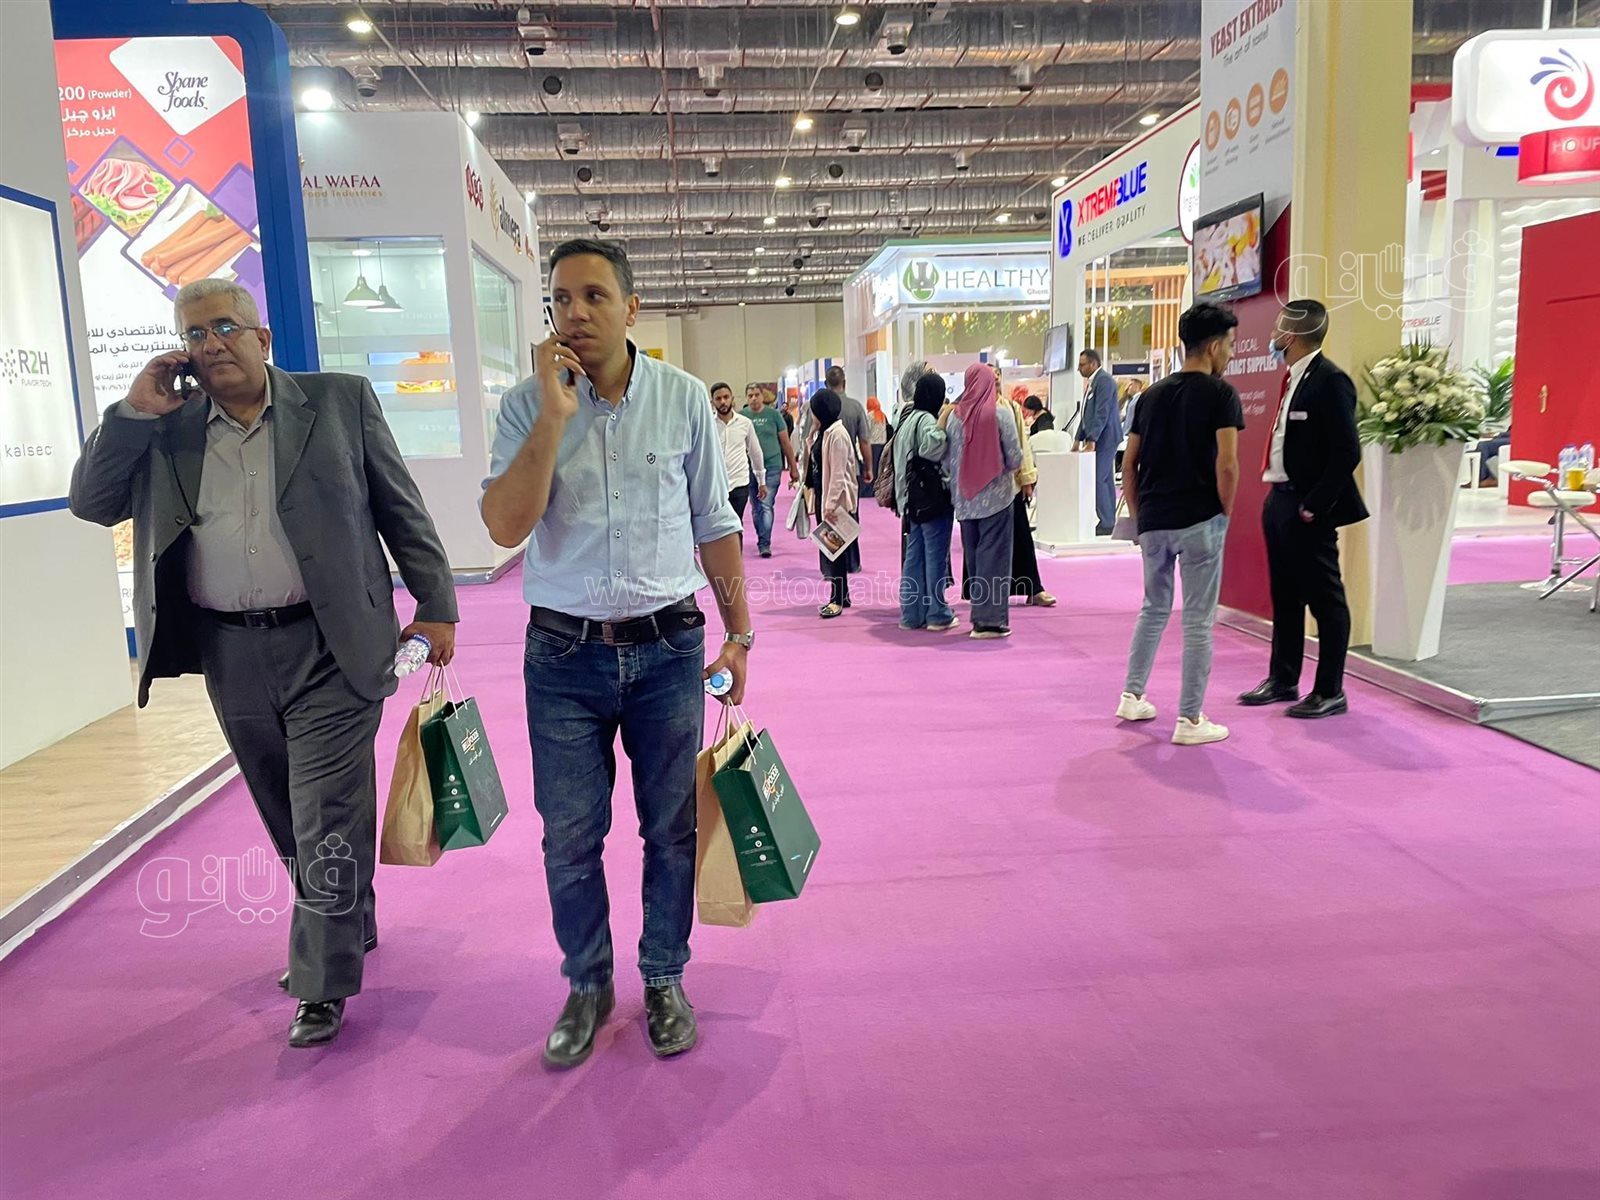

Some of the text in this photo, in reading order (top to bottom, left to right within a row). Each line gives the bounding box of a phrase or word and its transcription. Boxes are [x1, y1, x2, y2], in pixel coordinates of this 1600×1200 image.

[1210, 16, 1238, 59] YEAST
[157, 71, 208, 96] Shane
[88, 88, 132, 101] (Powder)
[163, 90, 206, 112] foods
[92, 106, 116, 120] ايزو
[92, 126, 116, 137] بديل
[302, 174, 381, 189] AL WAFAA
[1077, 161, 1147, 228] XTREMEBLUE
[1116, 203, 1146, 230] QUALITY
[944, 268, 1049, 289] HEALTHY
[109, 342, 129, 357] في
[18, 349, 50, 376] R2H
[4, 443, 53, 458] kalsec
